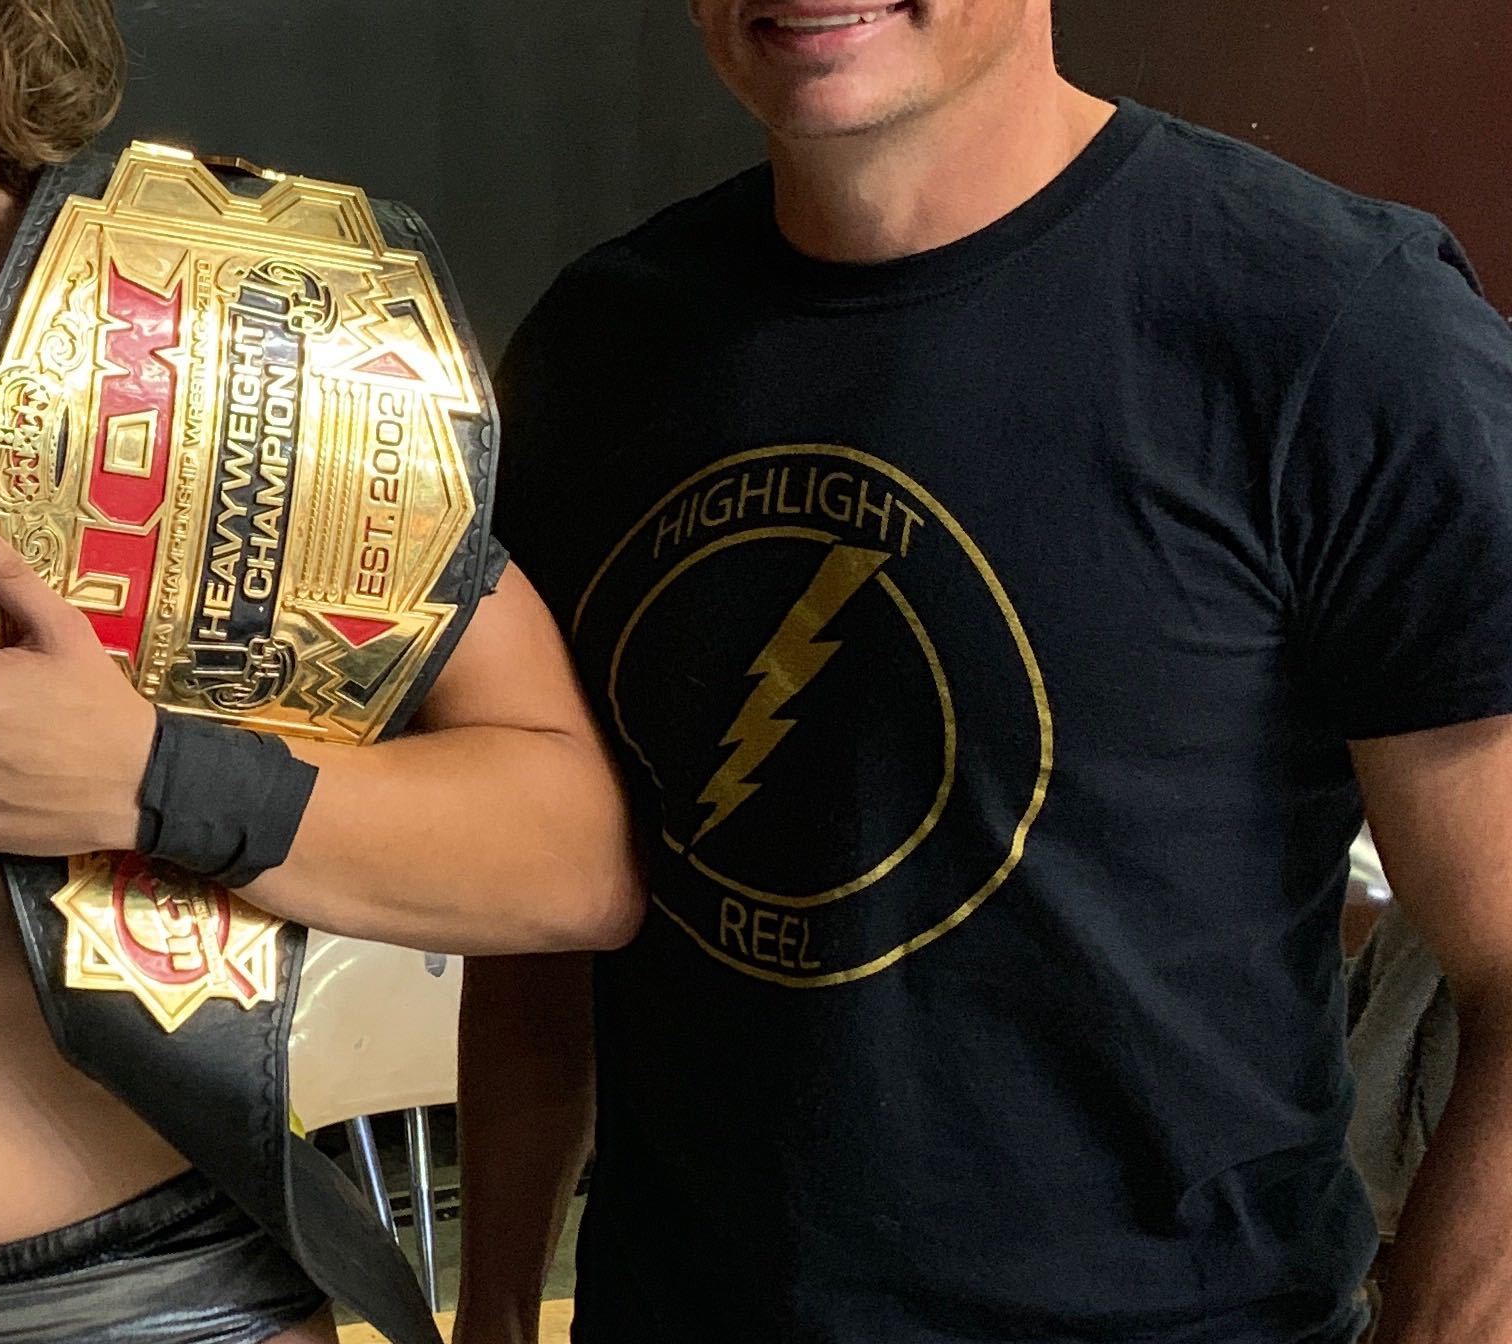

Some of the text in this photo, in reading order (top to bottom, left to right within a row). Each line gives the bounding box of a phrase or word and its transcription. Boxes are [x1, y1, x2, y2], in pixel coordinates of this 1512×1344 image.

[160, 454, 200, 619] CHAMPIONSHIP
[198, 313, 267, 641] HEAVYWEIGHT
[243, 364, 298, 600] CHAMPION
[357, 392, 407, 598] EST. 2002
[652, 466, 925, 559] HIGHLIGHT
[719, 900, 821, 971] REEL
